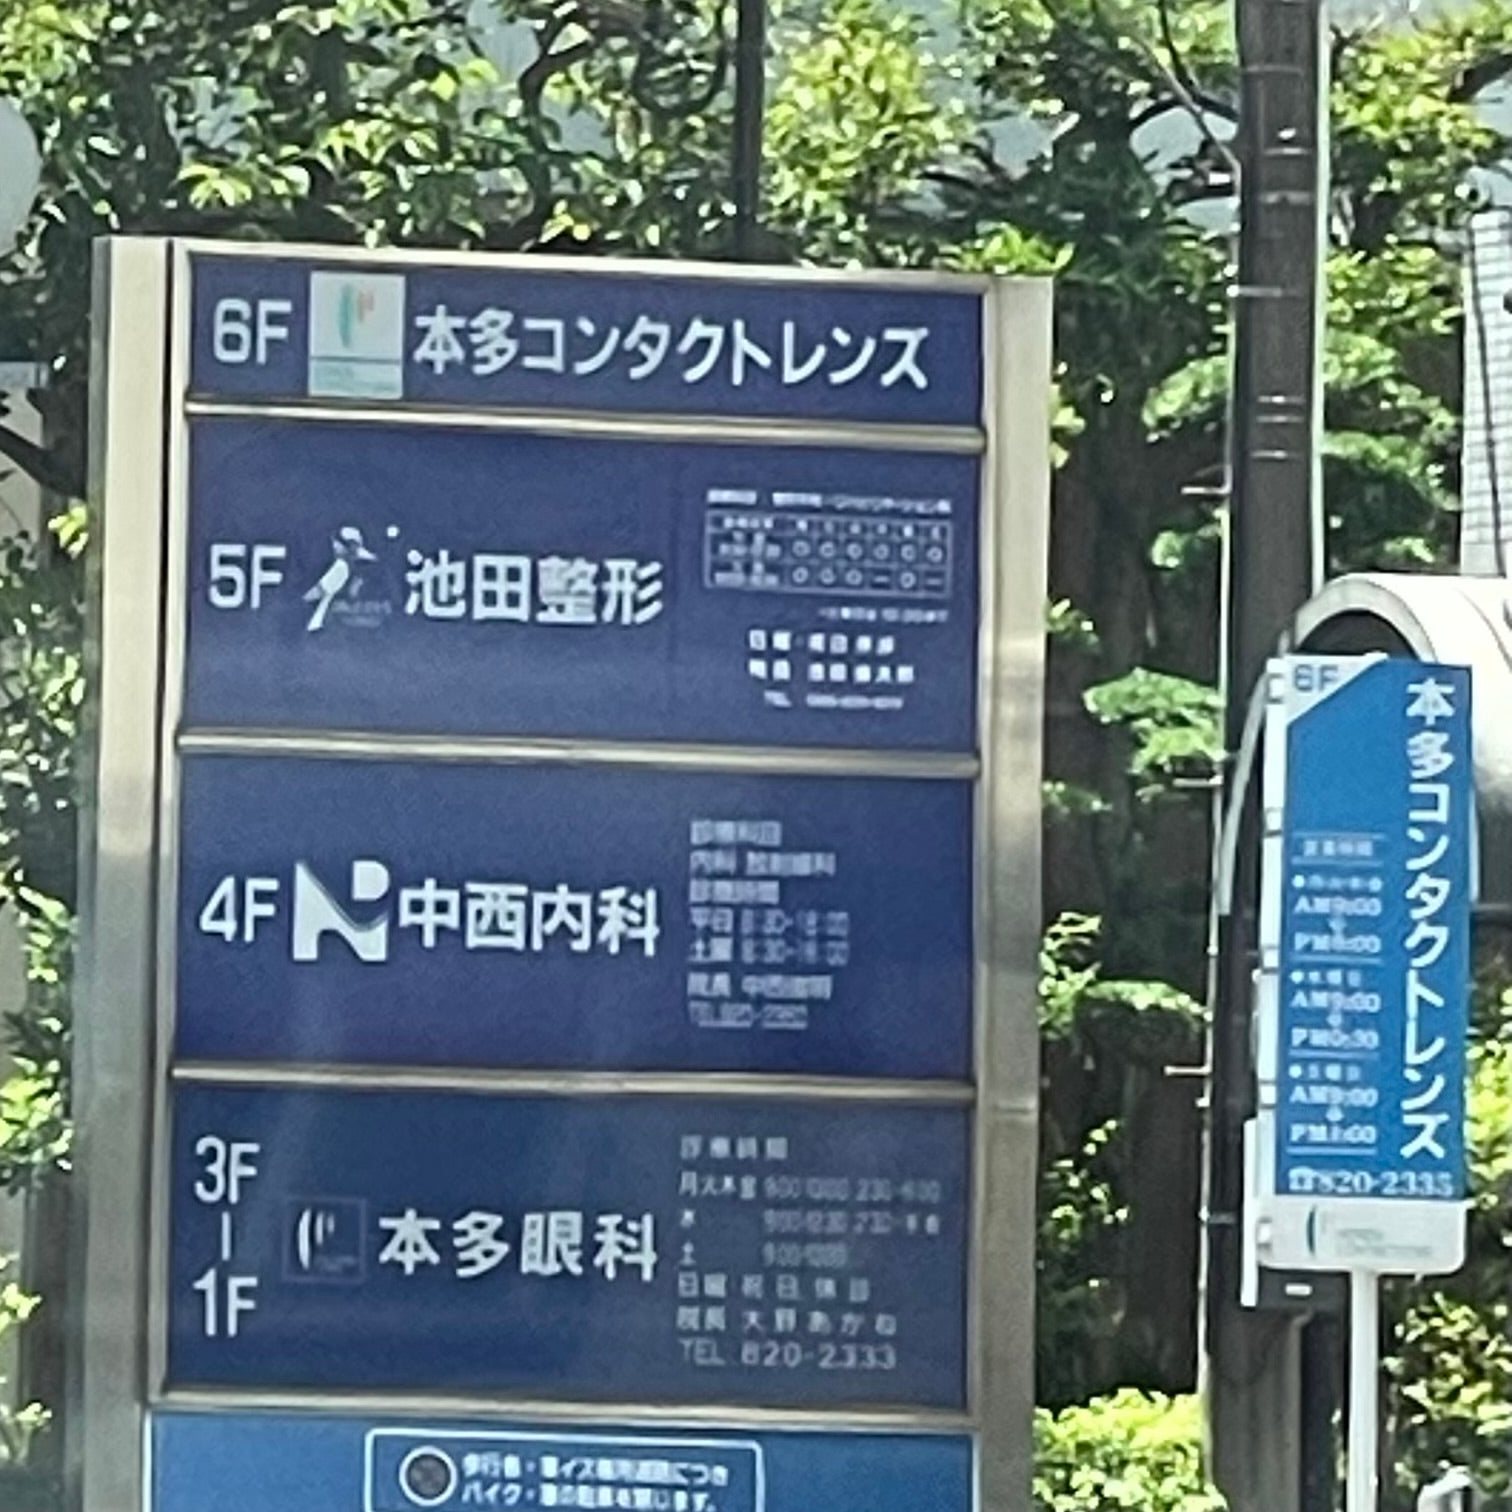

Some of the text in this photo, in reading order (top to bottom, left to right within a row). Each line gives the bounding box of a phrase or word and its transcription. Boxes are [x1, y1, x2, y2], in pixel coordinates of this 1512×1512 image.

[213, 298, 292, 364] 6F
[413, 304, 929, 388] 本多コンタクトレンズ
[209, 543, 286, 609] 5F
[405, 549, 663, 625] 池田整形
[199, 876, 661, 957] 4F 中西内科
[1400, 677, 1455, 1159] 本多コンタクトレンズ
[195, 1136, 260, 1204] 3F
[378, 1208, 657, 1281] 本多眼科
[193, 1268, 258, 1337] 1F
[681, 1339, 897, 1369] TEL 820-2333
